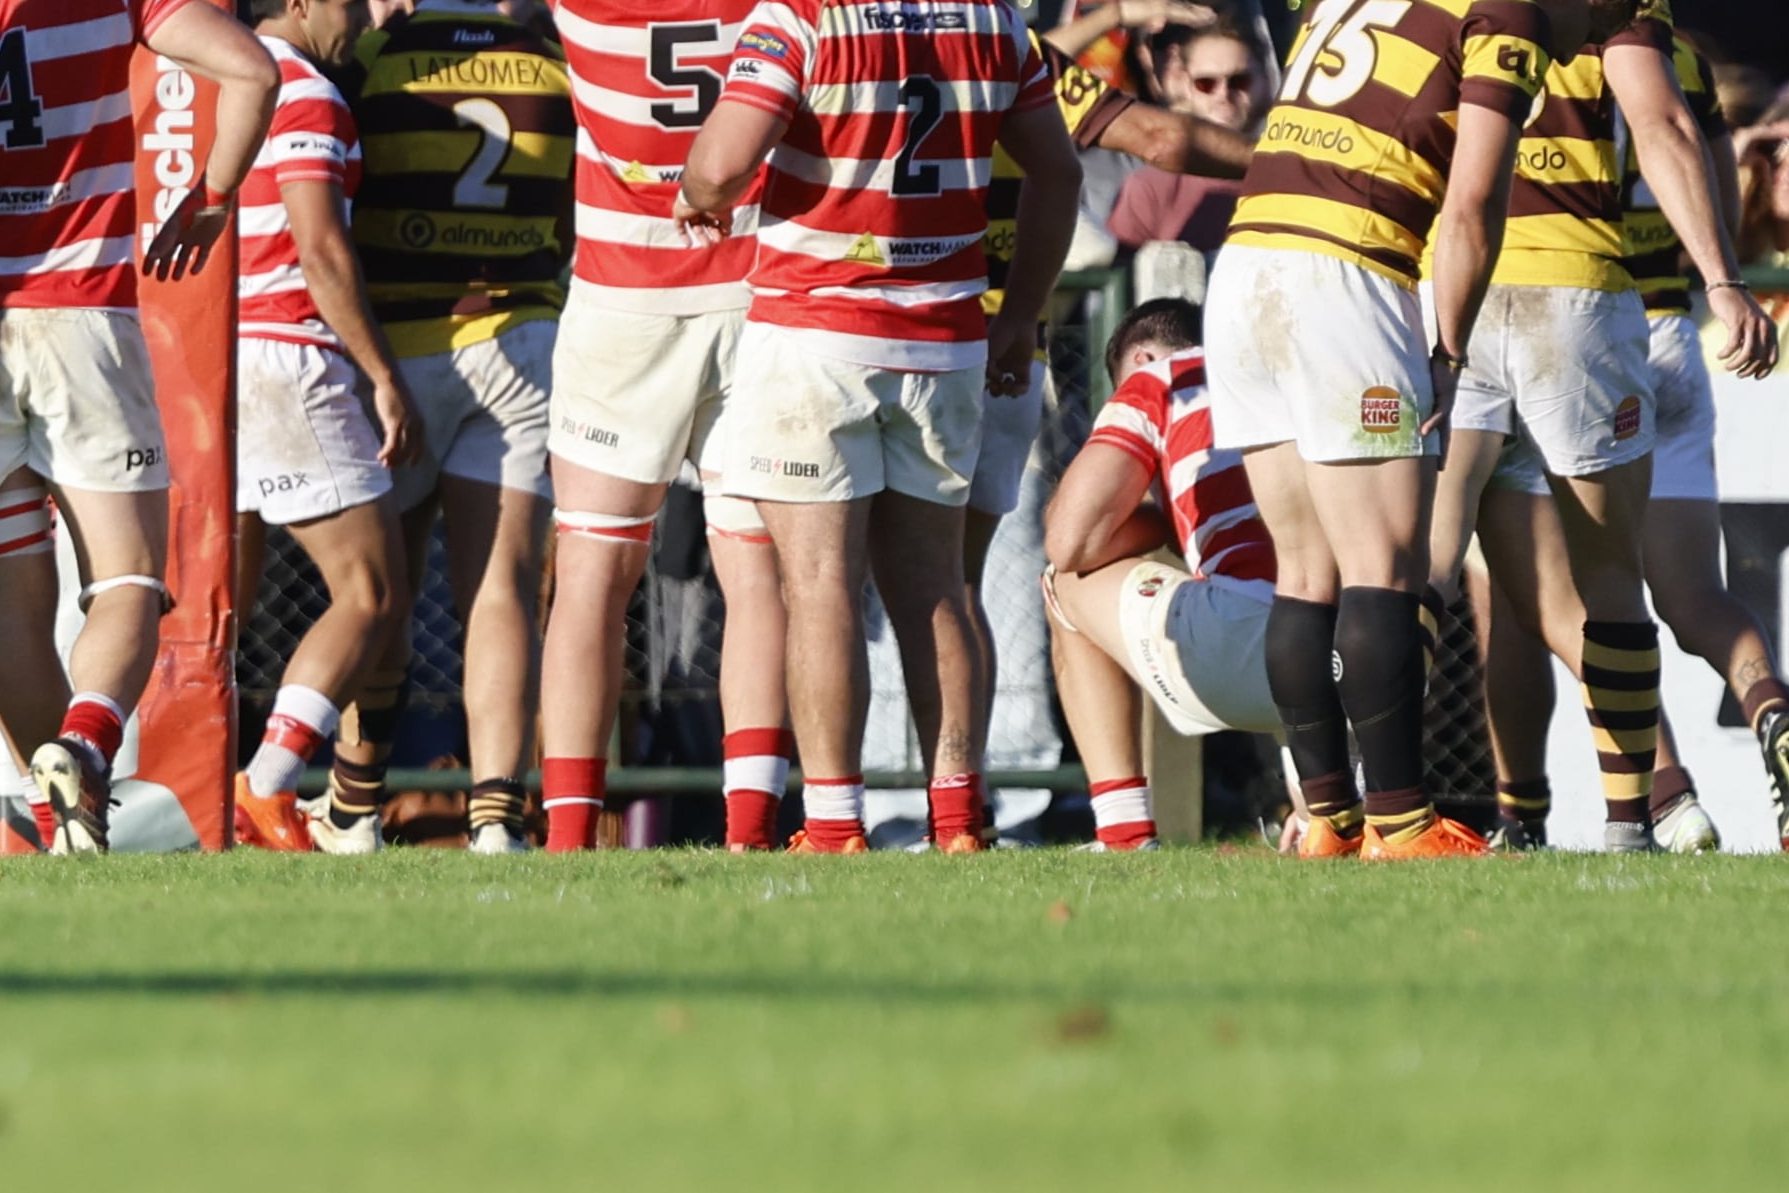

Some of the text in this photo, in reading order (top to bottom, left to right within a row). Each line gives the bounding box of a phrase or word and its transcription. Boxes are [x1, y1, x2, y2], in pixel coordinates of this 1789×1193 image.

[864, 6, 933, 31] fischer
[410, 56, 548, 87] LATCOMEX
[648, 21, 722, 130] 5
[888, 74, 945, 198] 2
[1267, 117, 1355, 154] almundo
[452, 96, 511, 208] 2
[440, 221, 545, 248] almundo
[1362, 399, 1400, 410] BURGER
[1362, 409, 1400, 425] KING
[584, 425, 619, 448] LIDER
[783, 461, 820, 478] LIDER
[258, 471, 311, 498] pax
